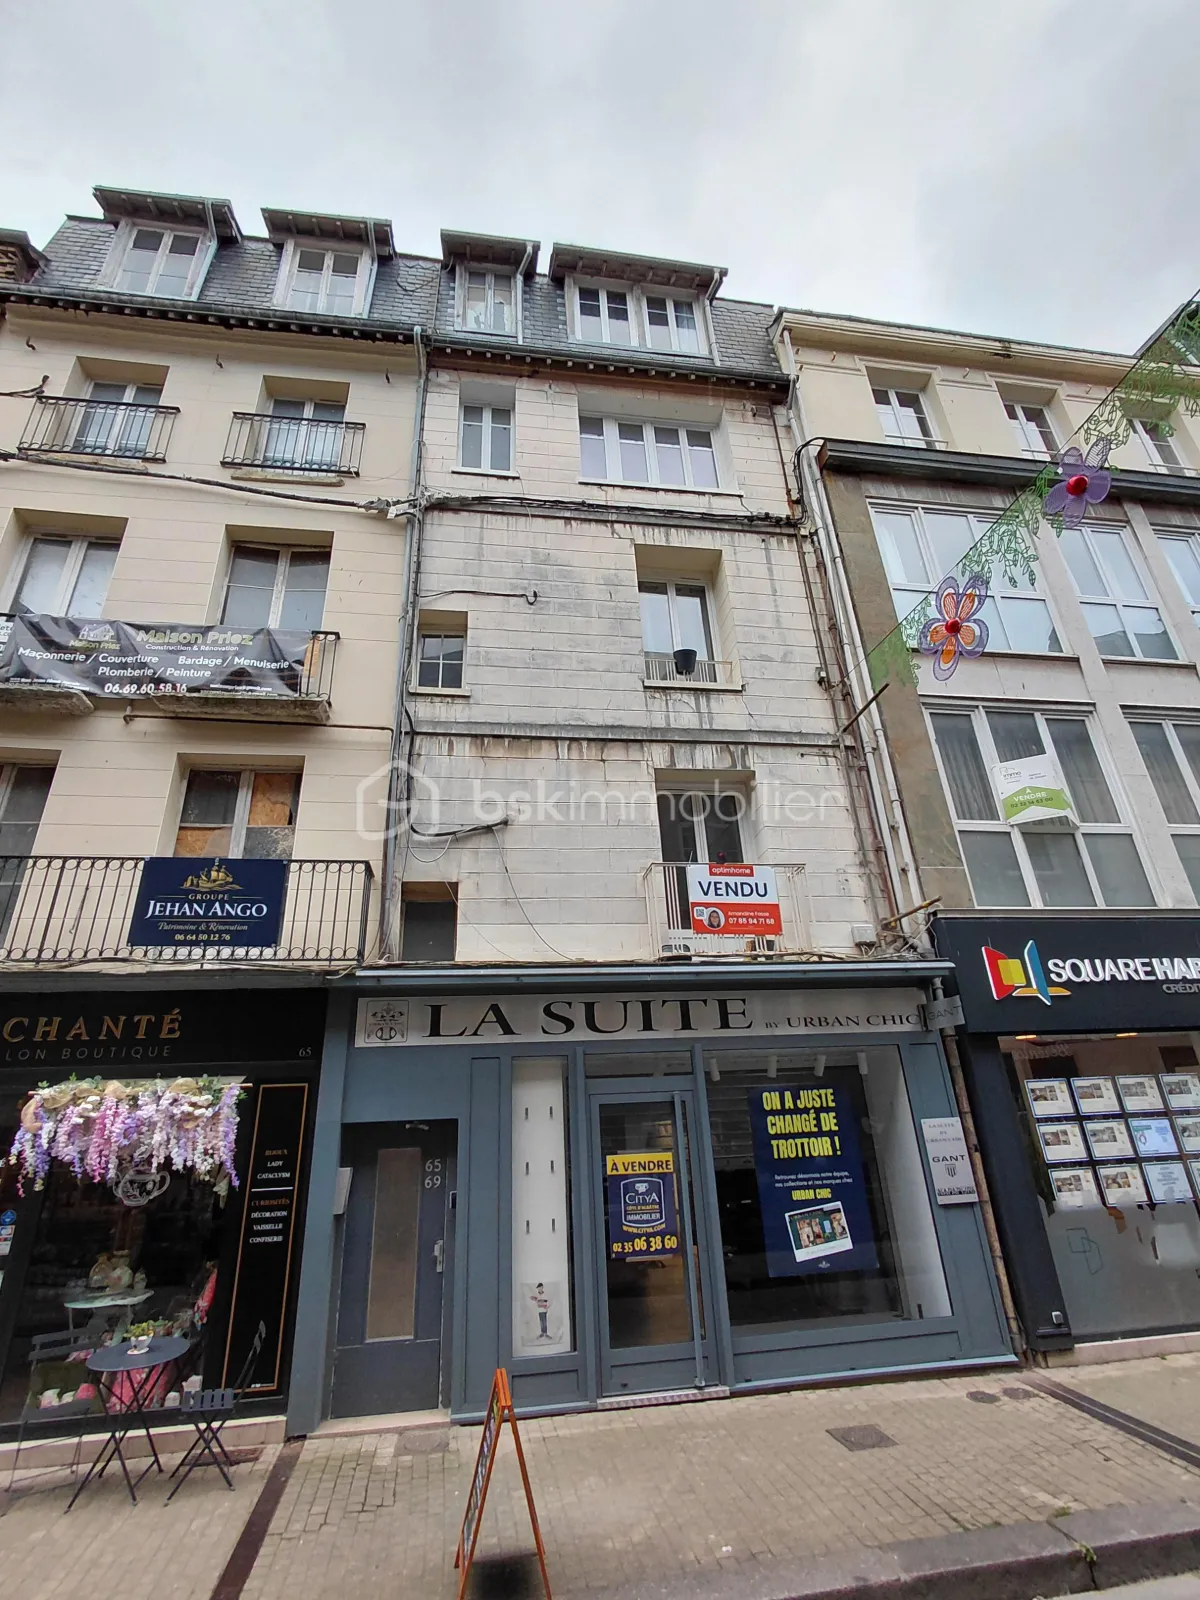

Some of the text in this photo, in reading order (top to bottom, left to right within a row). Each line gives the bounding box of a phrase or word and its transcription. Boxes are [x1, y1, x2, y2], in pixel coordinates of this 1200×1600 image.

[137, 629, 254, 646] Maison Priez
[145, 643, 191, 651] Construction
[18, 646, 86, 662] Maçonnerie
[98, 653, 159, 664] Couverture
[178, 655, 223, 668] Bardage
[233, 656, 290, 670] Menuiserie
[98, 666, 154, 677] Plomberie
[166, 667, 212, 678] Peinture
[104, 682, 188, 694] 06.69.60.58.16
[1014, 791, 1047, 802] VENDRE
[712, 867, 751, 875] optimhome
[698, 881, 768, 898] VENDU
[144, 900, 268, 919] JEHAN ANGO
[157, 922, 248, 931] Patrimoine & Rénovation
[174, 933, 231, 941] 06 64 50 12 76
[422, 999, 753, 1038] LA SUITE
[928, 1004, 961, 1023] GANT
[765, 1012, 921, 1029] BY URBAN CHIC
[61, 1045, 171, 1060] BOUTIQUE
[299, 1047, 312, 1057] 65
[762, 1088, 836, 1111] ON A JUSTE
[766, 1109, 839, 1135] CHANGÉ DE
[770, 1136, 833, 1159] TROTTOIR
[932, 1154, 965, 1163] GANT
[425, 1159, 441, 1172] 65
[610, 1159, 672, 1173] À VENDRE
[424, 1175, 441, 1188] 69
[792, 1188, 832, 1200] URBAN CHIC
[251, 1210, 287, 1218] DÉCORATION
[626, 1213, 660, 1221] IMMOBILIER
[249, 1235, 283, 1243] CONFISERIE
[612, 1235, 677, 1253] 02 35 06 38 60
